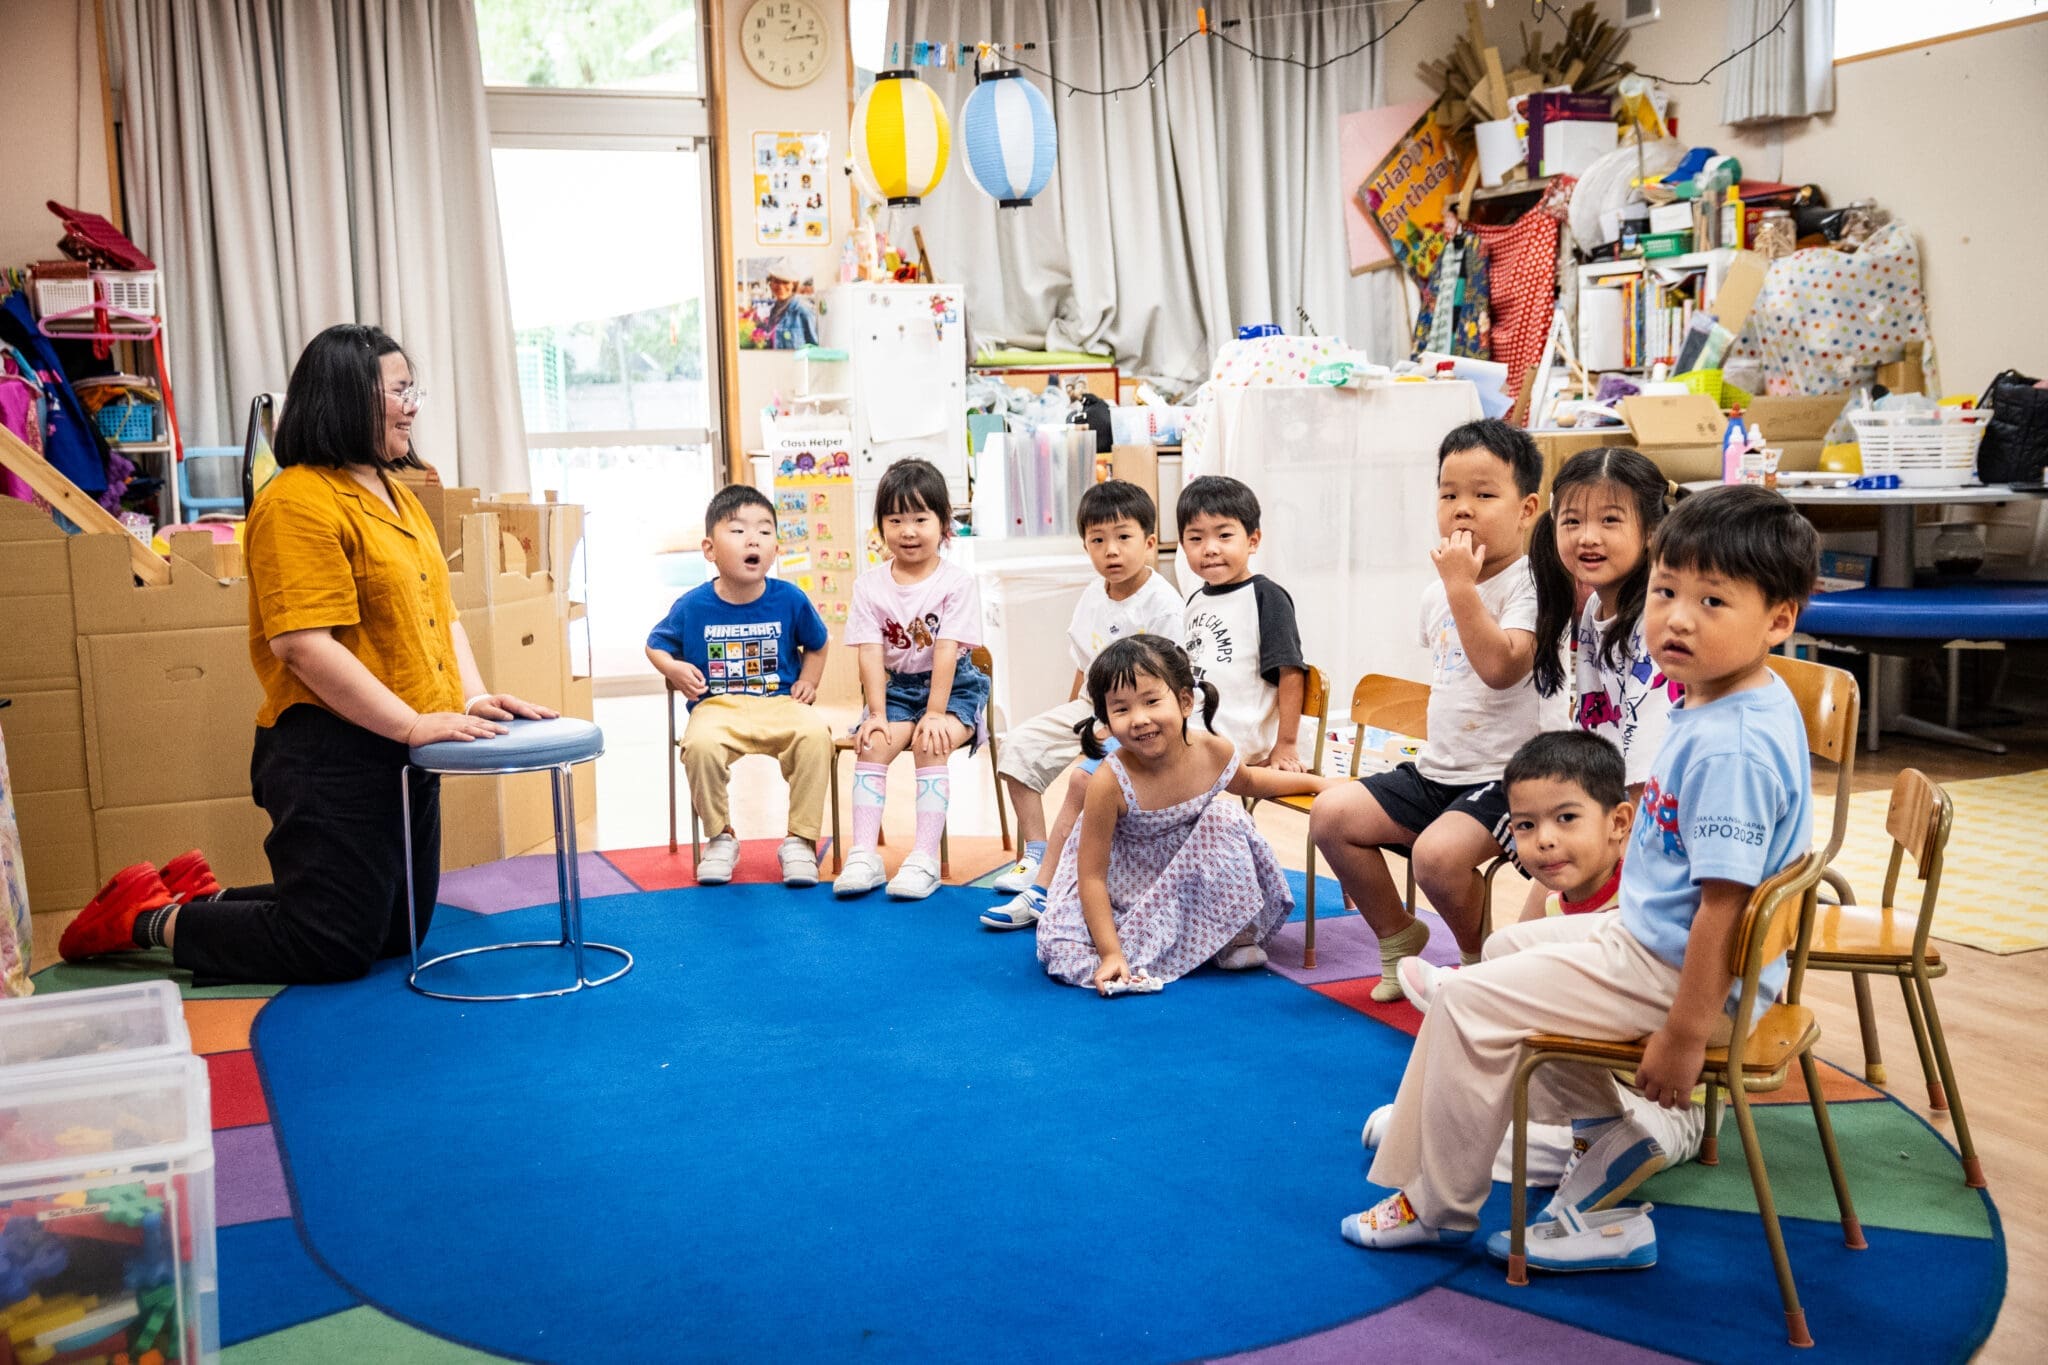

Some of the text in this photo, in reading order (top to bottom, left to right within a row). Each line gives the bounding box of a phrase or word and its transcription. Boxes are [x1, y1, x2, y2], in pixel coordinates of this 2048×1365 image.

[766, 6, 774, 19] 11
[780, 2, 790, 14] 12
[798, 7, 802, 19] 1
[757, 18, 766, 29] 10
[807, 20, 814, 30] 2
[753, 33, 761, 43] 9
[769, 60, 775, 72] 7
[784, 66, 791, 77] 6
[1376, 130, 1435, 199] Happy
[1381, 153, 1460, 235] Birthday
[780, 437, 843, 448] Class Helper
[704, 621, 782, 642] MINECRAFT
[1693, 823, 1764, 846] EXPO2025
